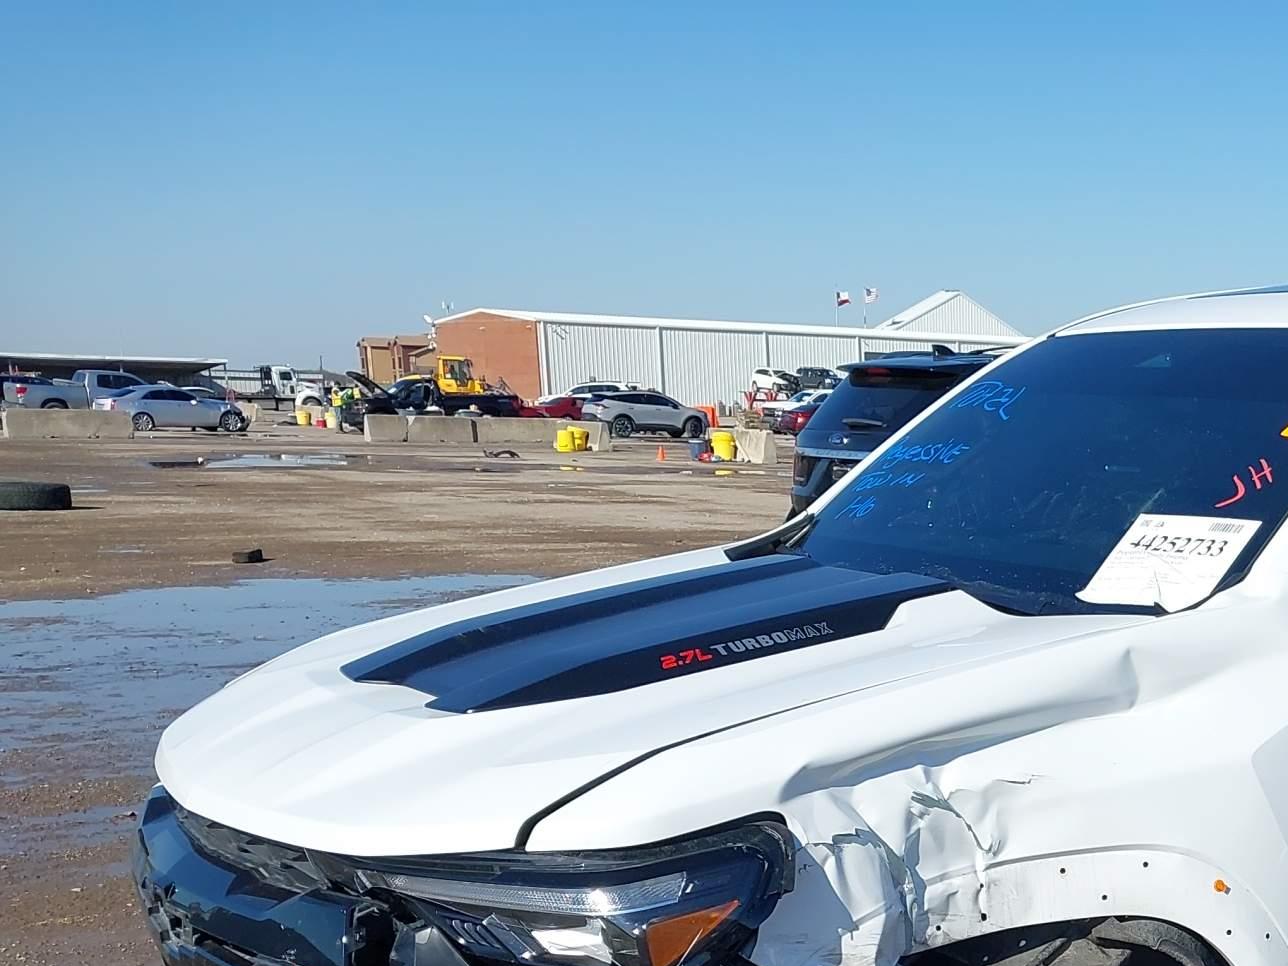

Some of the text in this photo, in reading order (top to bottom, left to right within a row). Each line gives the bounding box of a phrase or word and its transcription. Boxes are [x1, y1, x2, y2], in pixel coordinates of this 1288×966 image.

[1130, 534, 1228, 557] 44252733
[660, 622, 834, 670] 2.7L TURBOMAX
